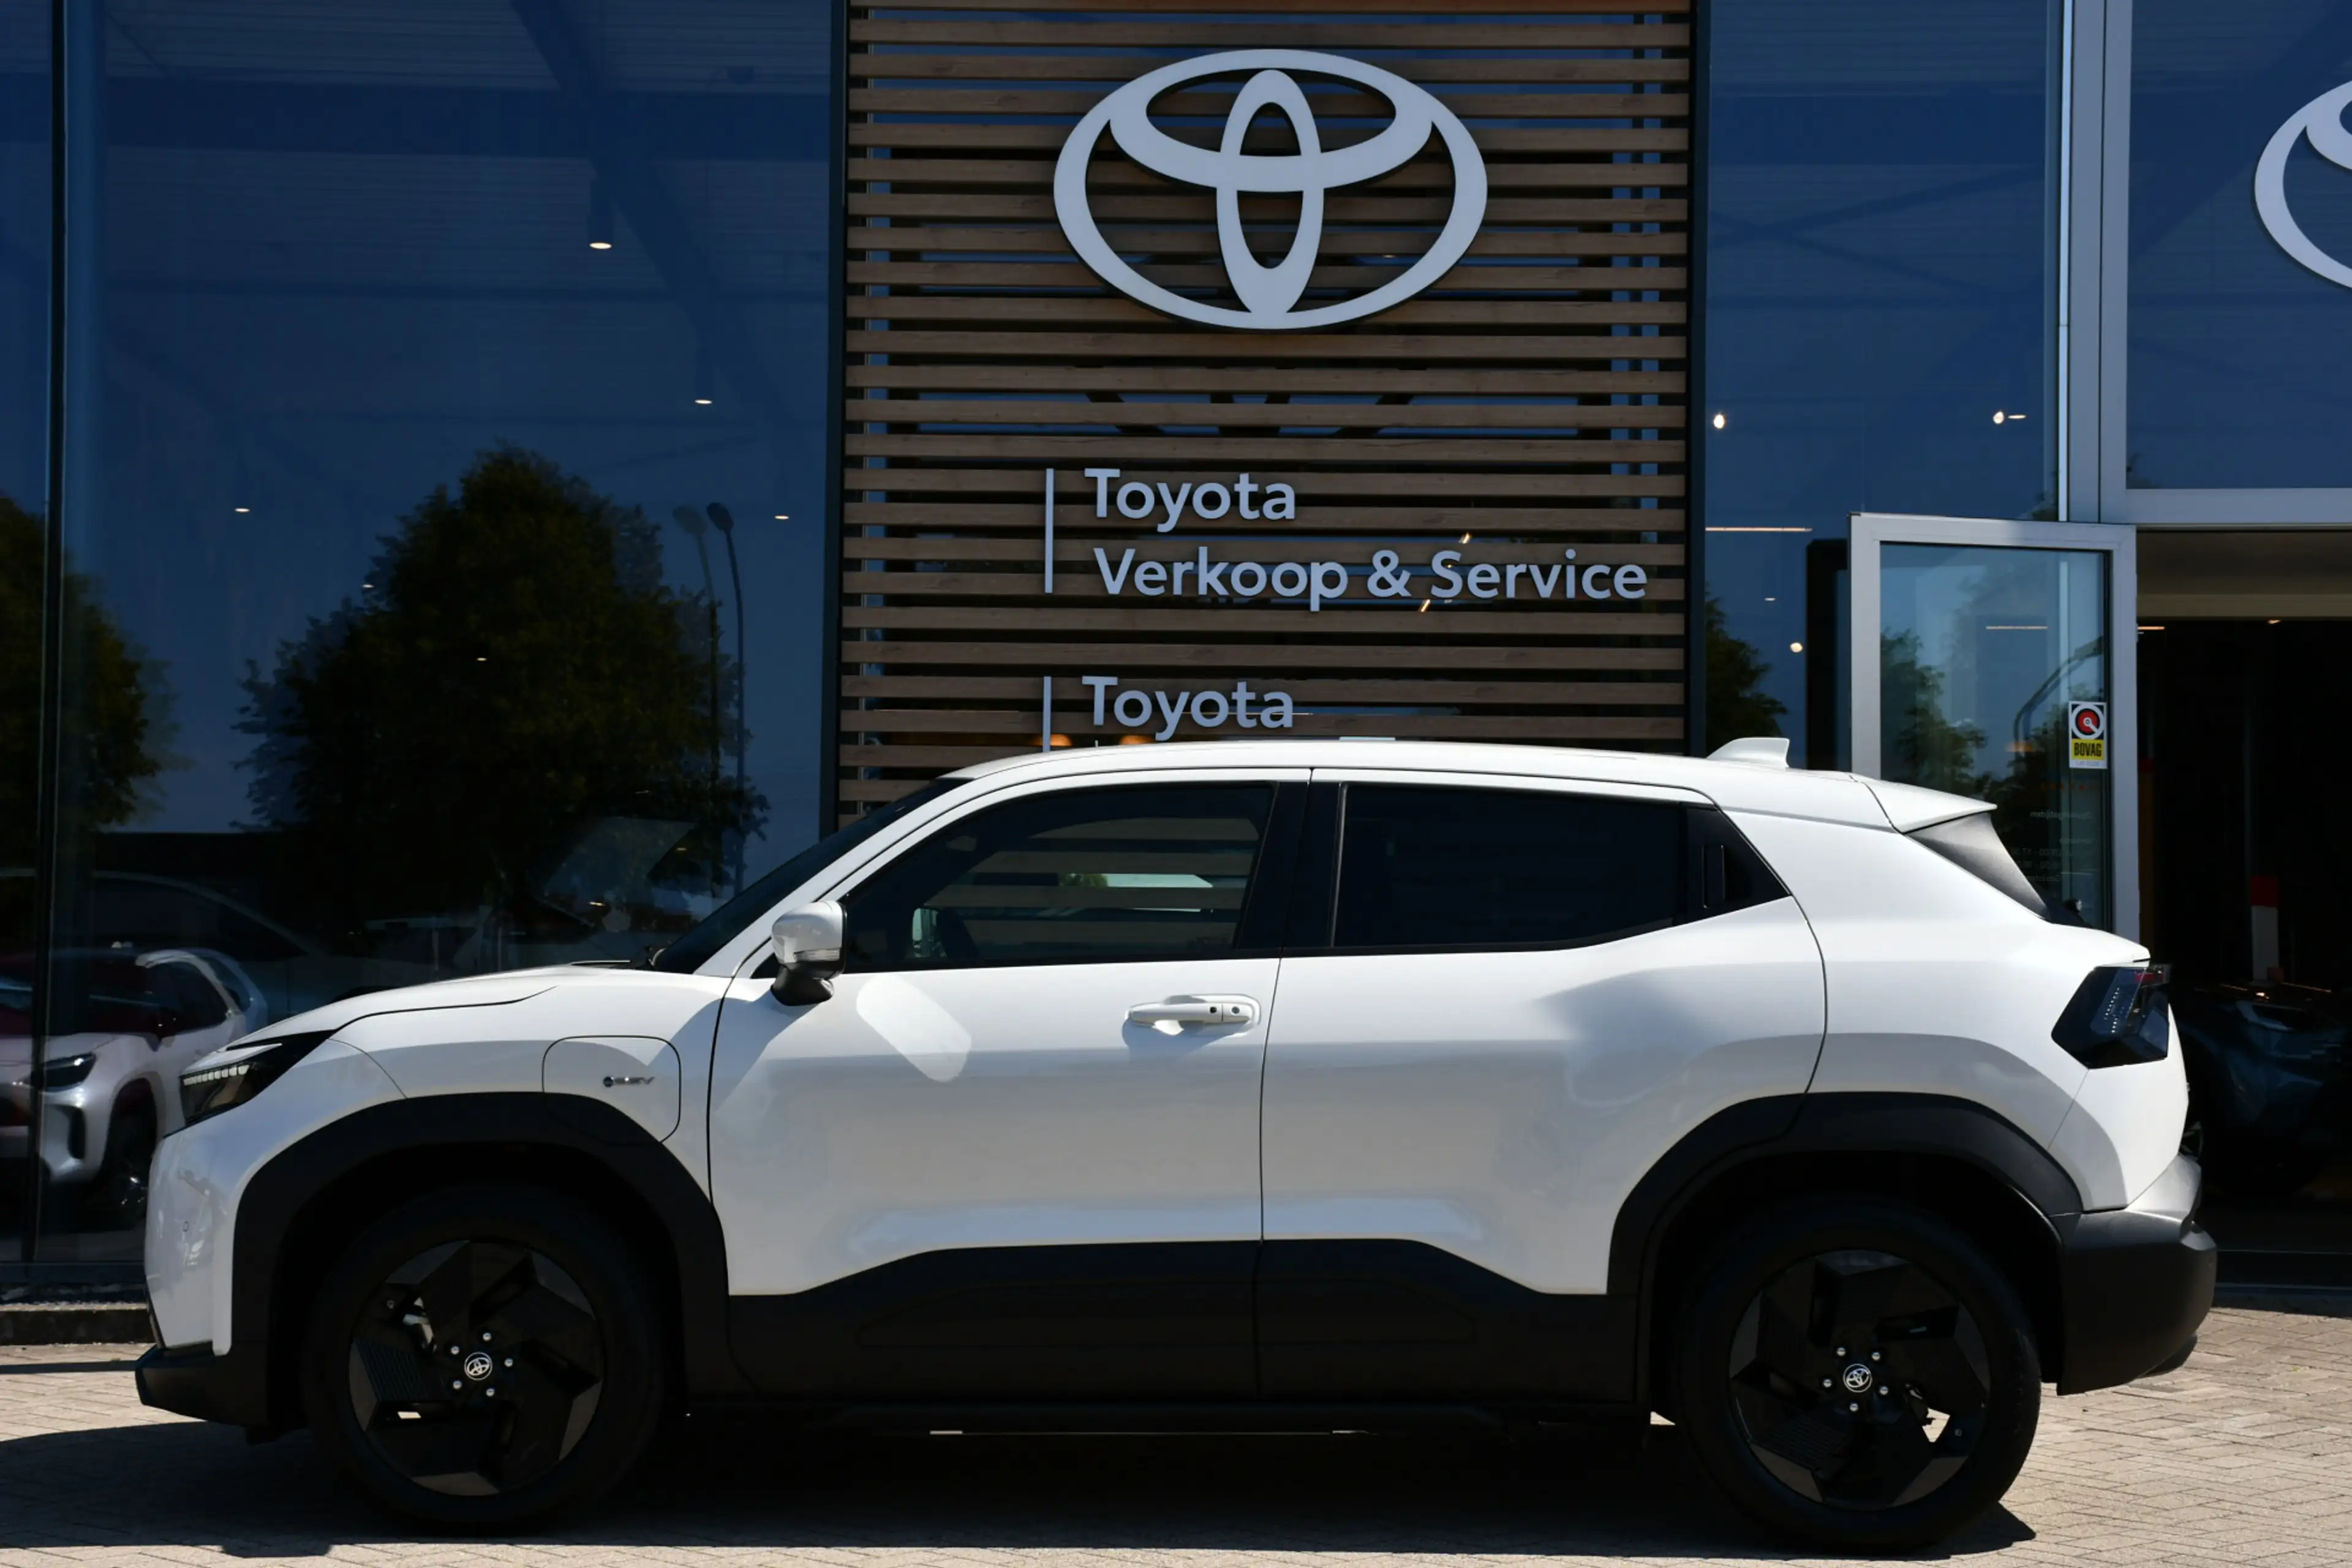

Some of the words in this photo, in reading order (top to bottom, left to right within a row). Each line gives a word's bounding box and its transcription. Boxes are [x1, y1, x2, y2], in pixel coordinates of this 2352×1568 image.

[1084, 468, 1296, 532] Toyota
[1093, 546, 1348, 611] Verkoop
[1367, 550, 1412, 598] &
[1431, 549, 1648, 599] Service
[1082, 676, 1294, 740] Toyota
[2073, 742, 2103, 757] BOVAG
